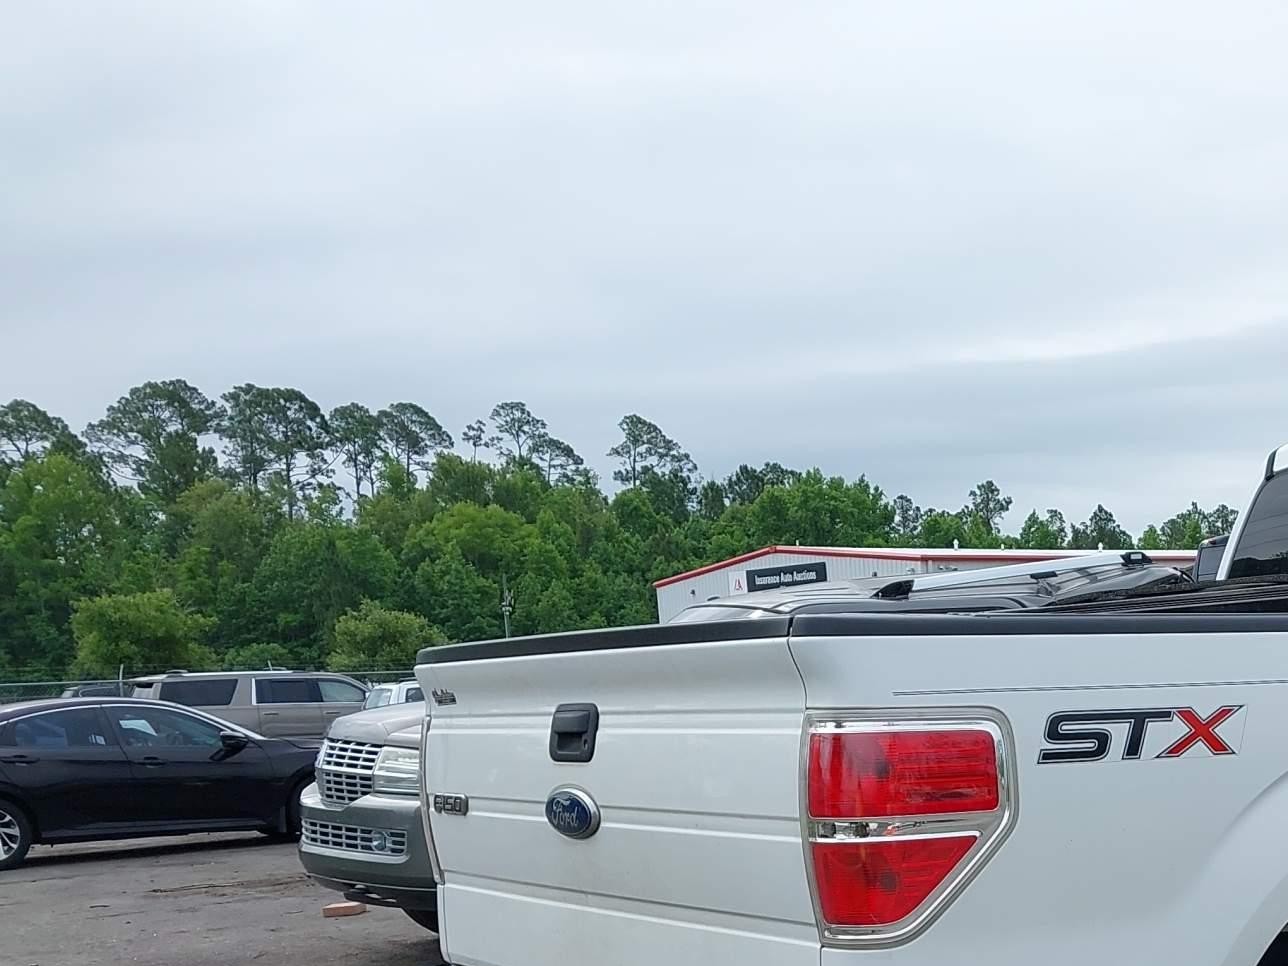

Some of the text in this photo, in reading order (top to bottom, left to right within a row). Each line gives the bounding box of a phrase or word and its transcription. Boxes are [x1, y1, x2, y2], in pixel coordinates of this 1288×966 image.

[781, 572, 793, 583] Auto
[793, 569, 817, 581] Auctions
[1037, 704, 1245, 764] STX
[552, 797, 579, 827] Ford
